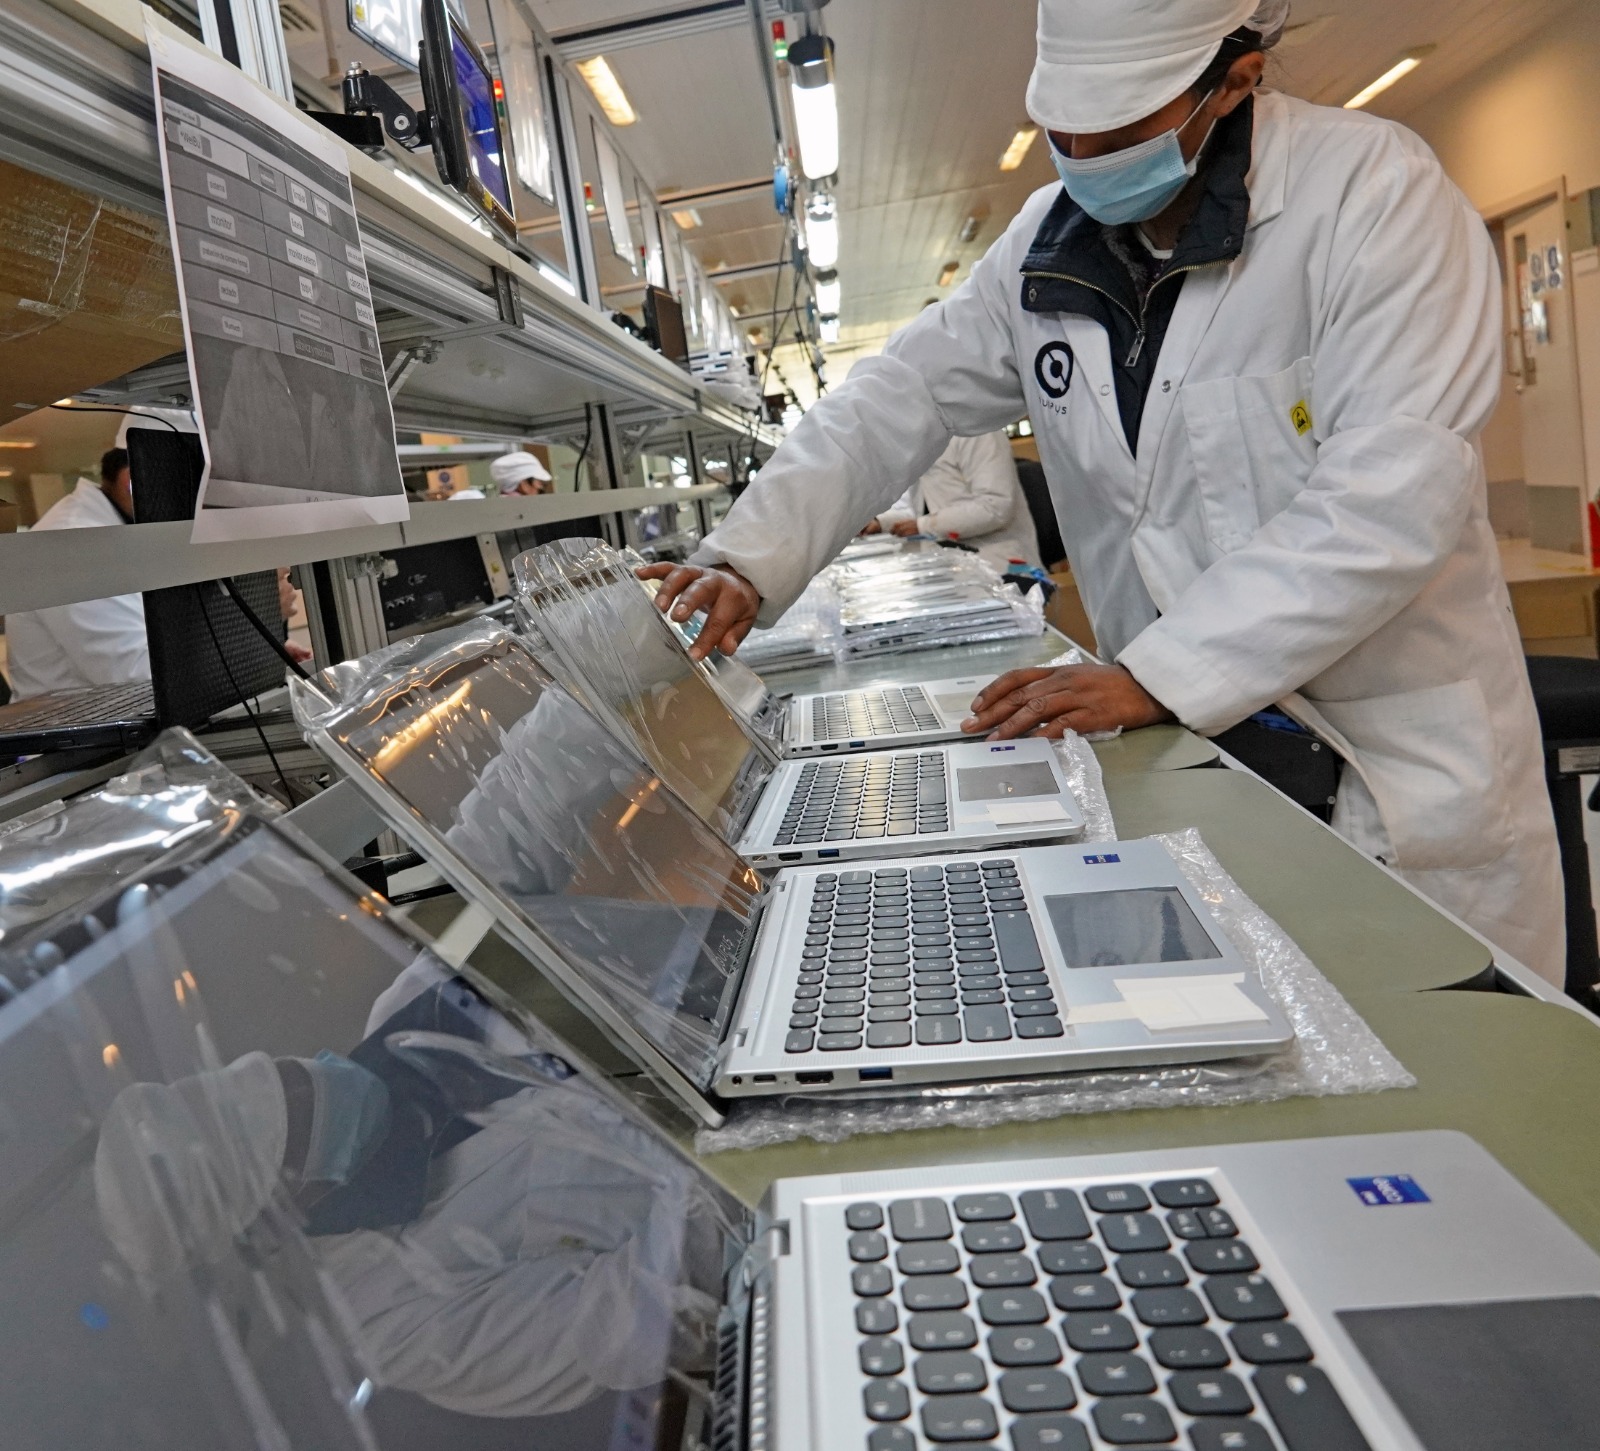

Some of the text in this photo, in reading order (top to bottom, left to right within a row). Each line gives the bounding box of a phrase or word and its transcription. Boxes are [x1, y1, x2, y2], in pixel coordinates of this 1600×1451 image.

[210, 214, 233, 229] monitor
[1090, 1324, 1111, 1335] L
[1013, 1337, 1035, 1350] O
[1105, 1365, 1128, 1379] K
[1121, 1412, 1147, 1425] J
[1038, 1428, 1063, 1443] U
